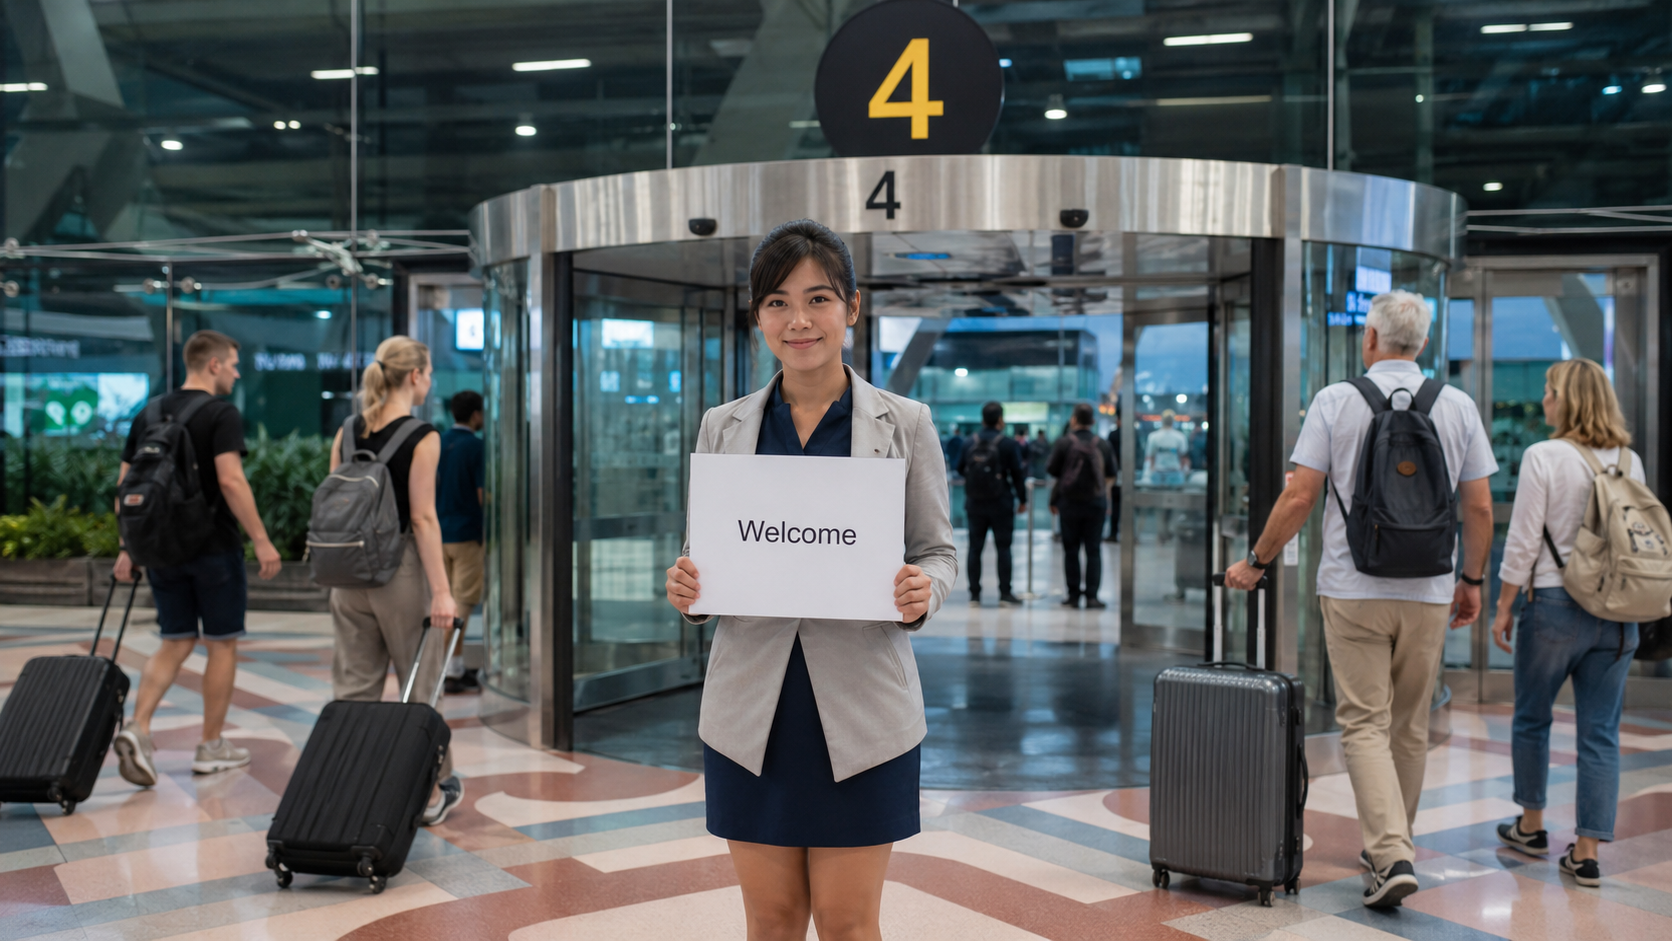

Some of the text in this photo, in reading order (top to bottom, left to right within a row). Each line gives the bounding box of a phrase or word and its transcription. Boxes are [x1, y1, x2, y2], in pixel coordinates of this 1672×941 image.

[868, 38, 944, 140] 4
[865, 171, 901, 220] 4
[738, 519, 857, 546] Welcome
